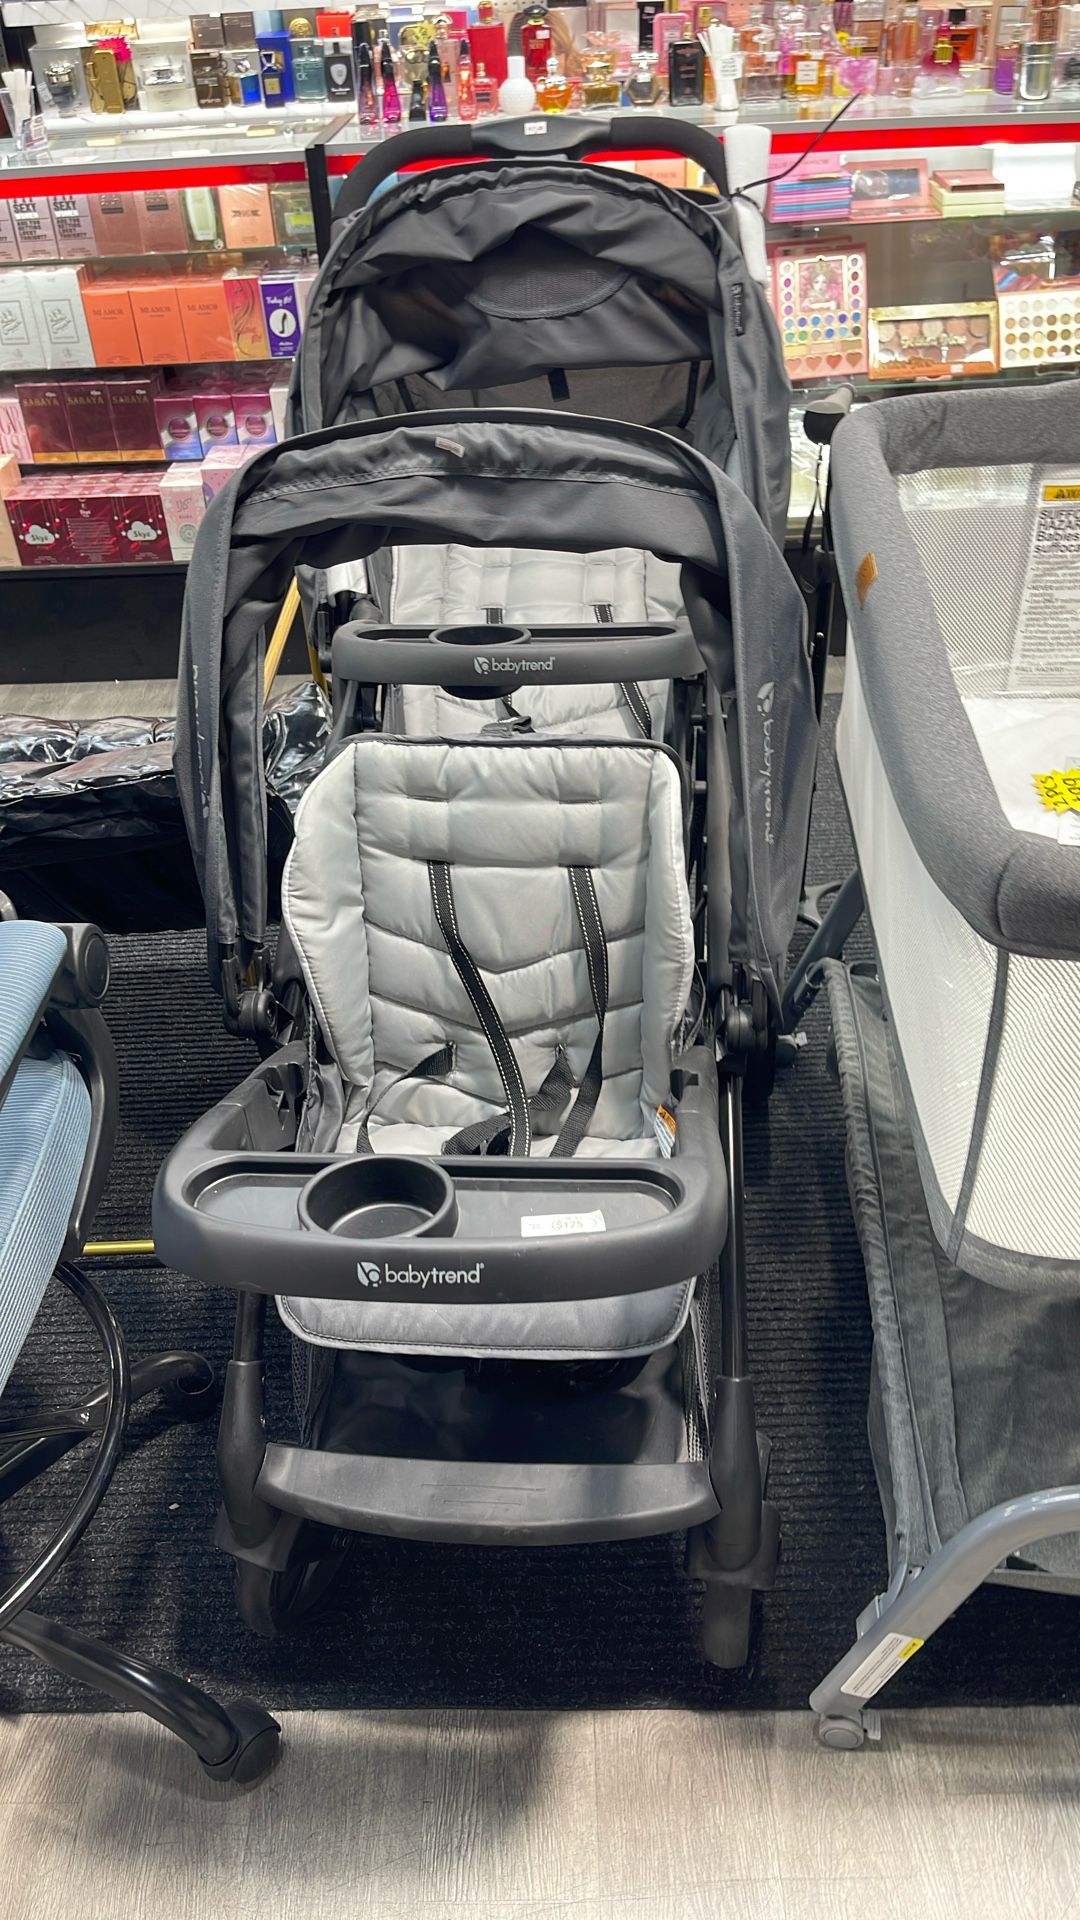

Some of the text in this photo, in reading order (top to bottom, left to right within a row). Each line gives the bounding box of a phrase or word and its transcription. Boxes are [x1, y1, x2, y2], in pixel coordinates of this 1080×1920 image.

[13, 203, 36, 213] SEXY
[53, 201, 76, 211] SEXY
[1036, 530, 1080, 542] Babies
[385, 1262, 481, 1289] babytrend
